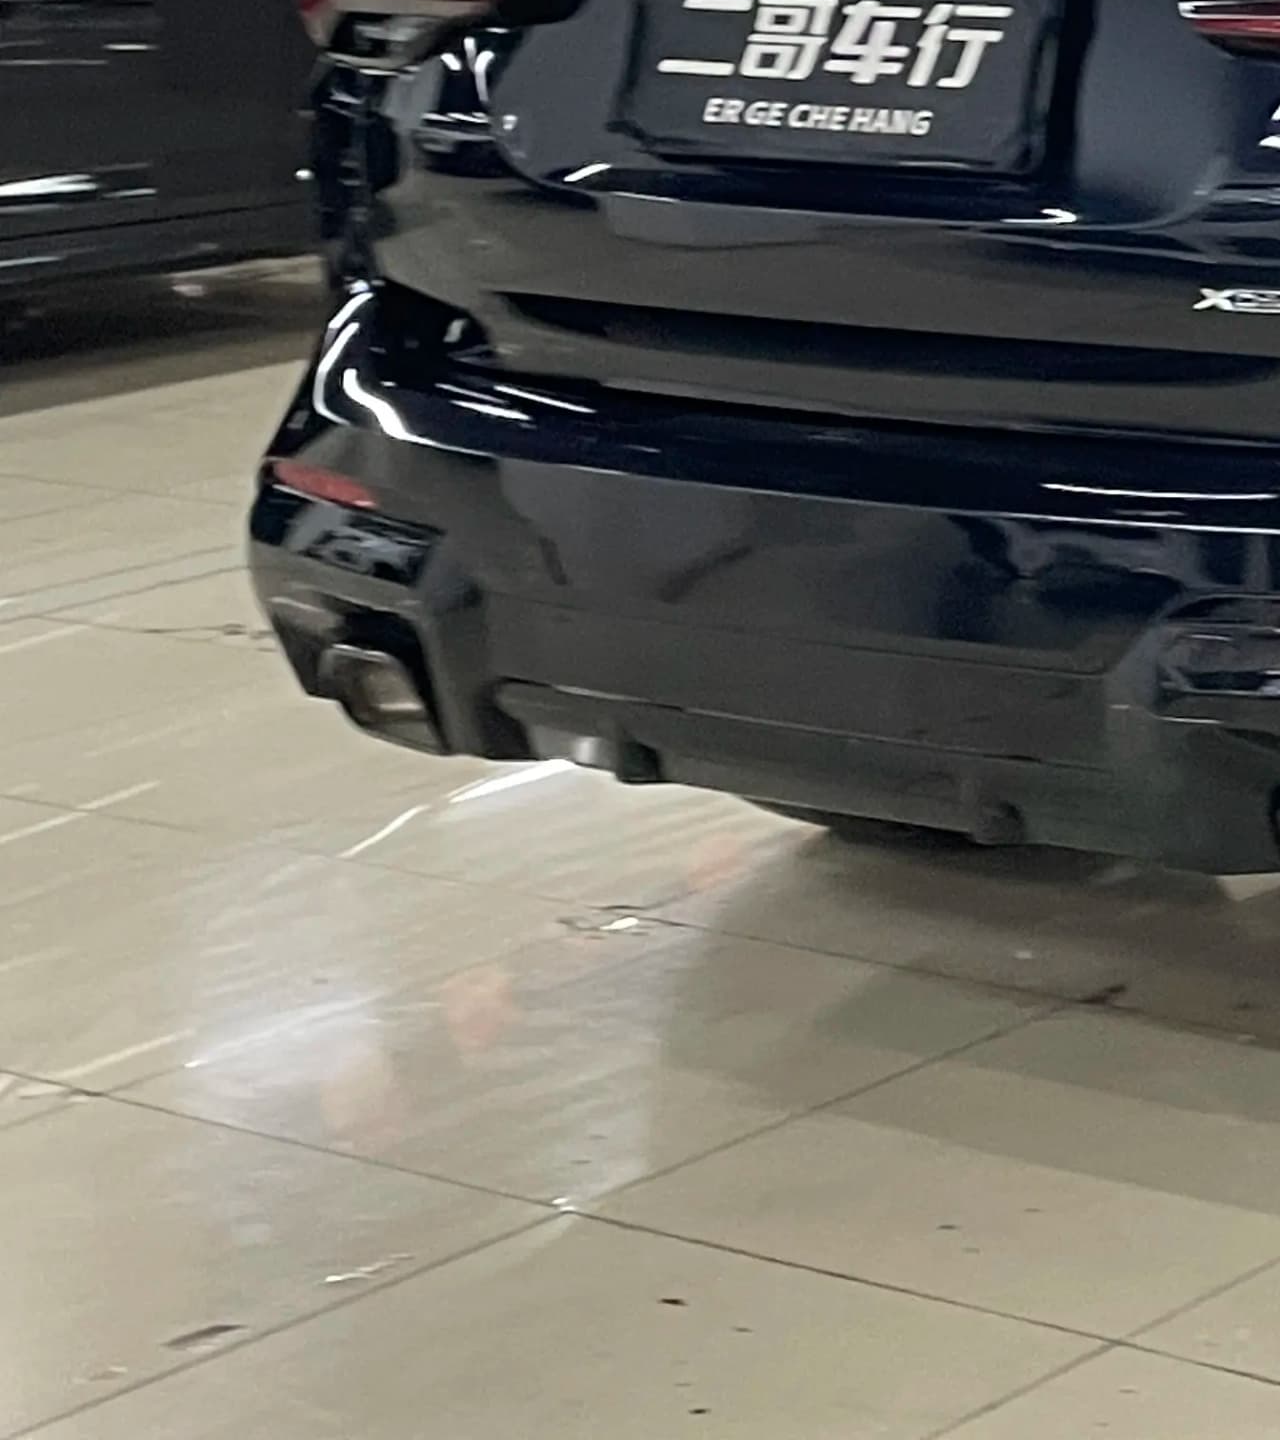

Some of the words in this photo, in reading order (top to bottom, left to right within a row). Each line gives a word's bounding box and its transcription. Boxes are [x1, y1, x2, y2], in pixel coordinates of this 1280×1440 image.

[702, 97, 745, 123] ER
[744, 101, 788, 126] GE
[787, 104, 850, 131] CHE
[847, 107, 935, 136] HANG
